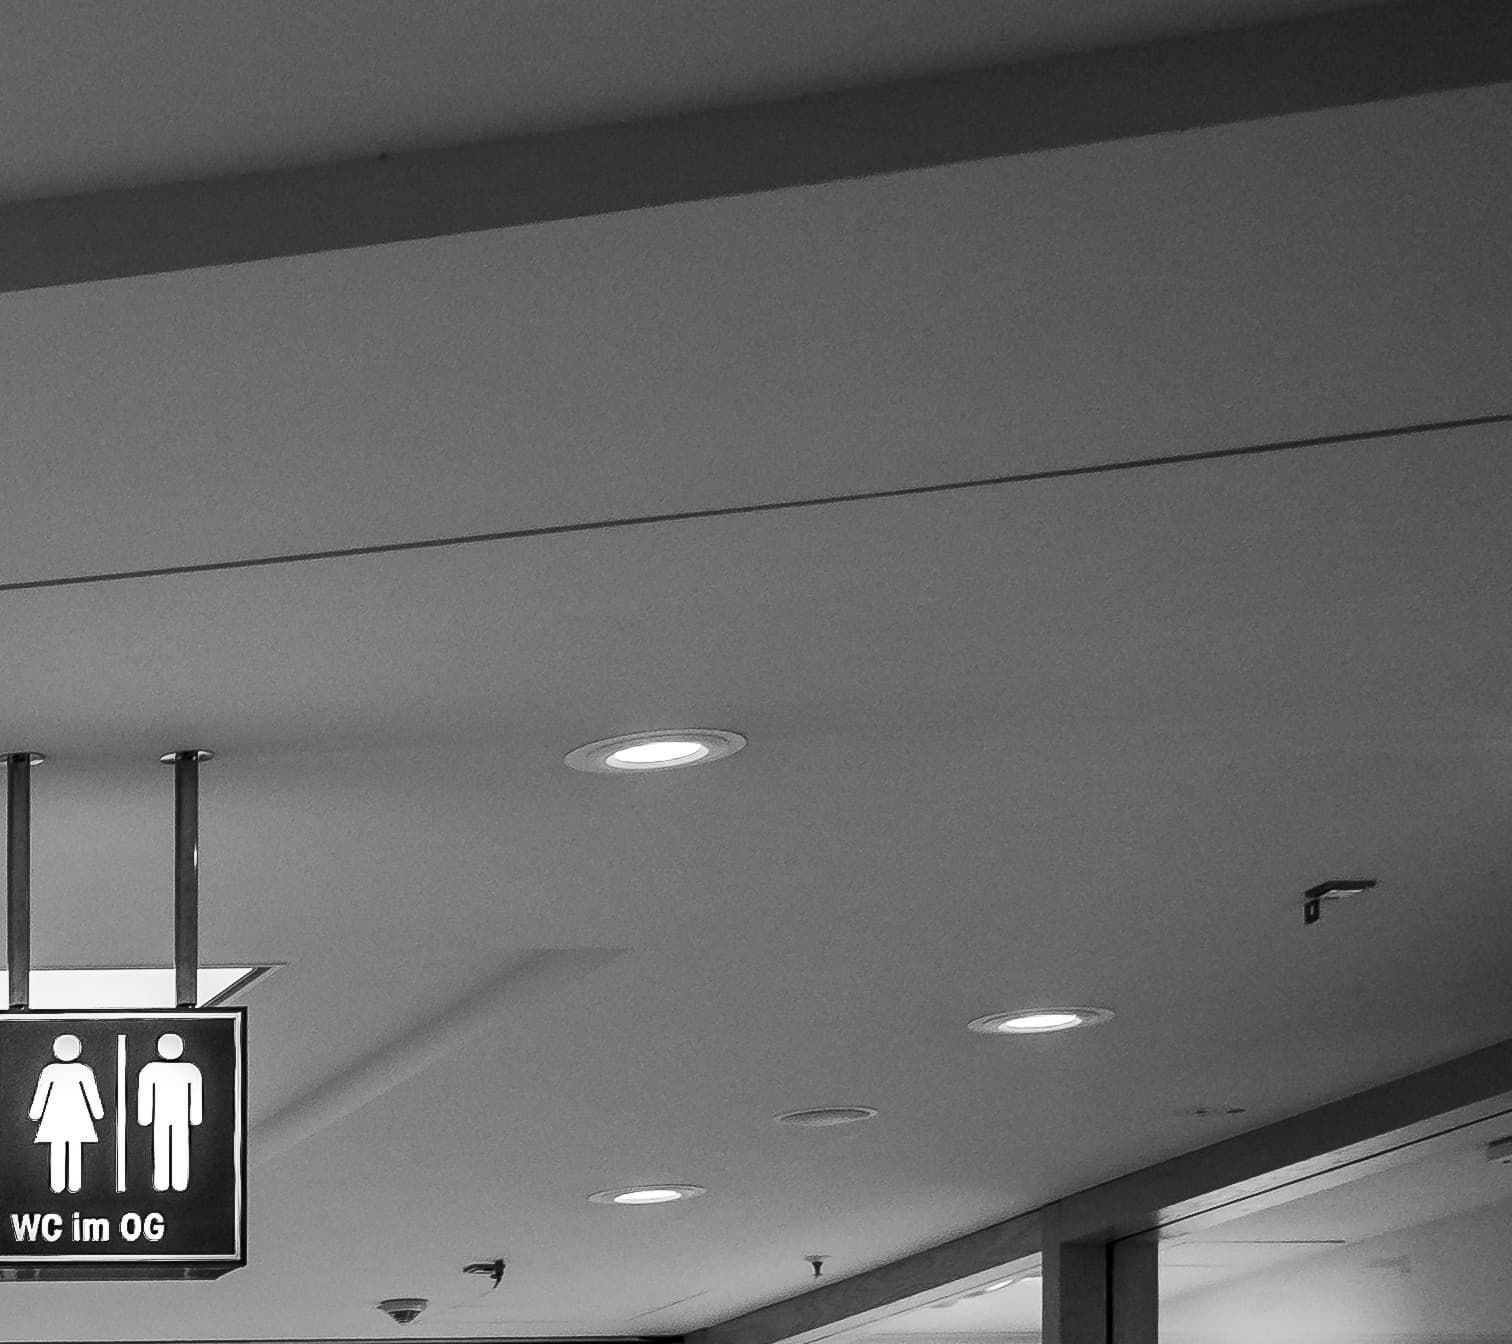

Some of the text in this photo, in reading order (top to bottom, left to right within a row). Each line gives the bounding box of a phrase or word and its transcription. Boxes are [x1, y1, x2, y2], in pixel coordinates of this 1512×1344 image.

[9, 1212, 166, 1243] WC im OG
